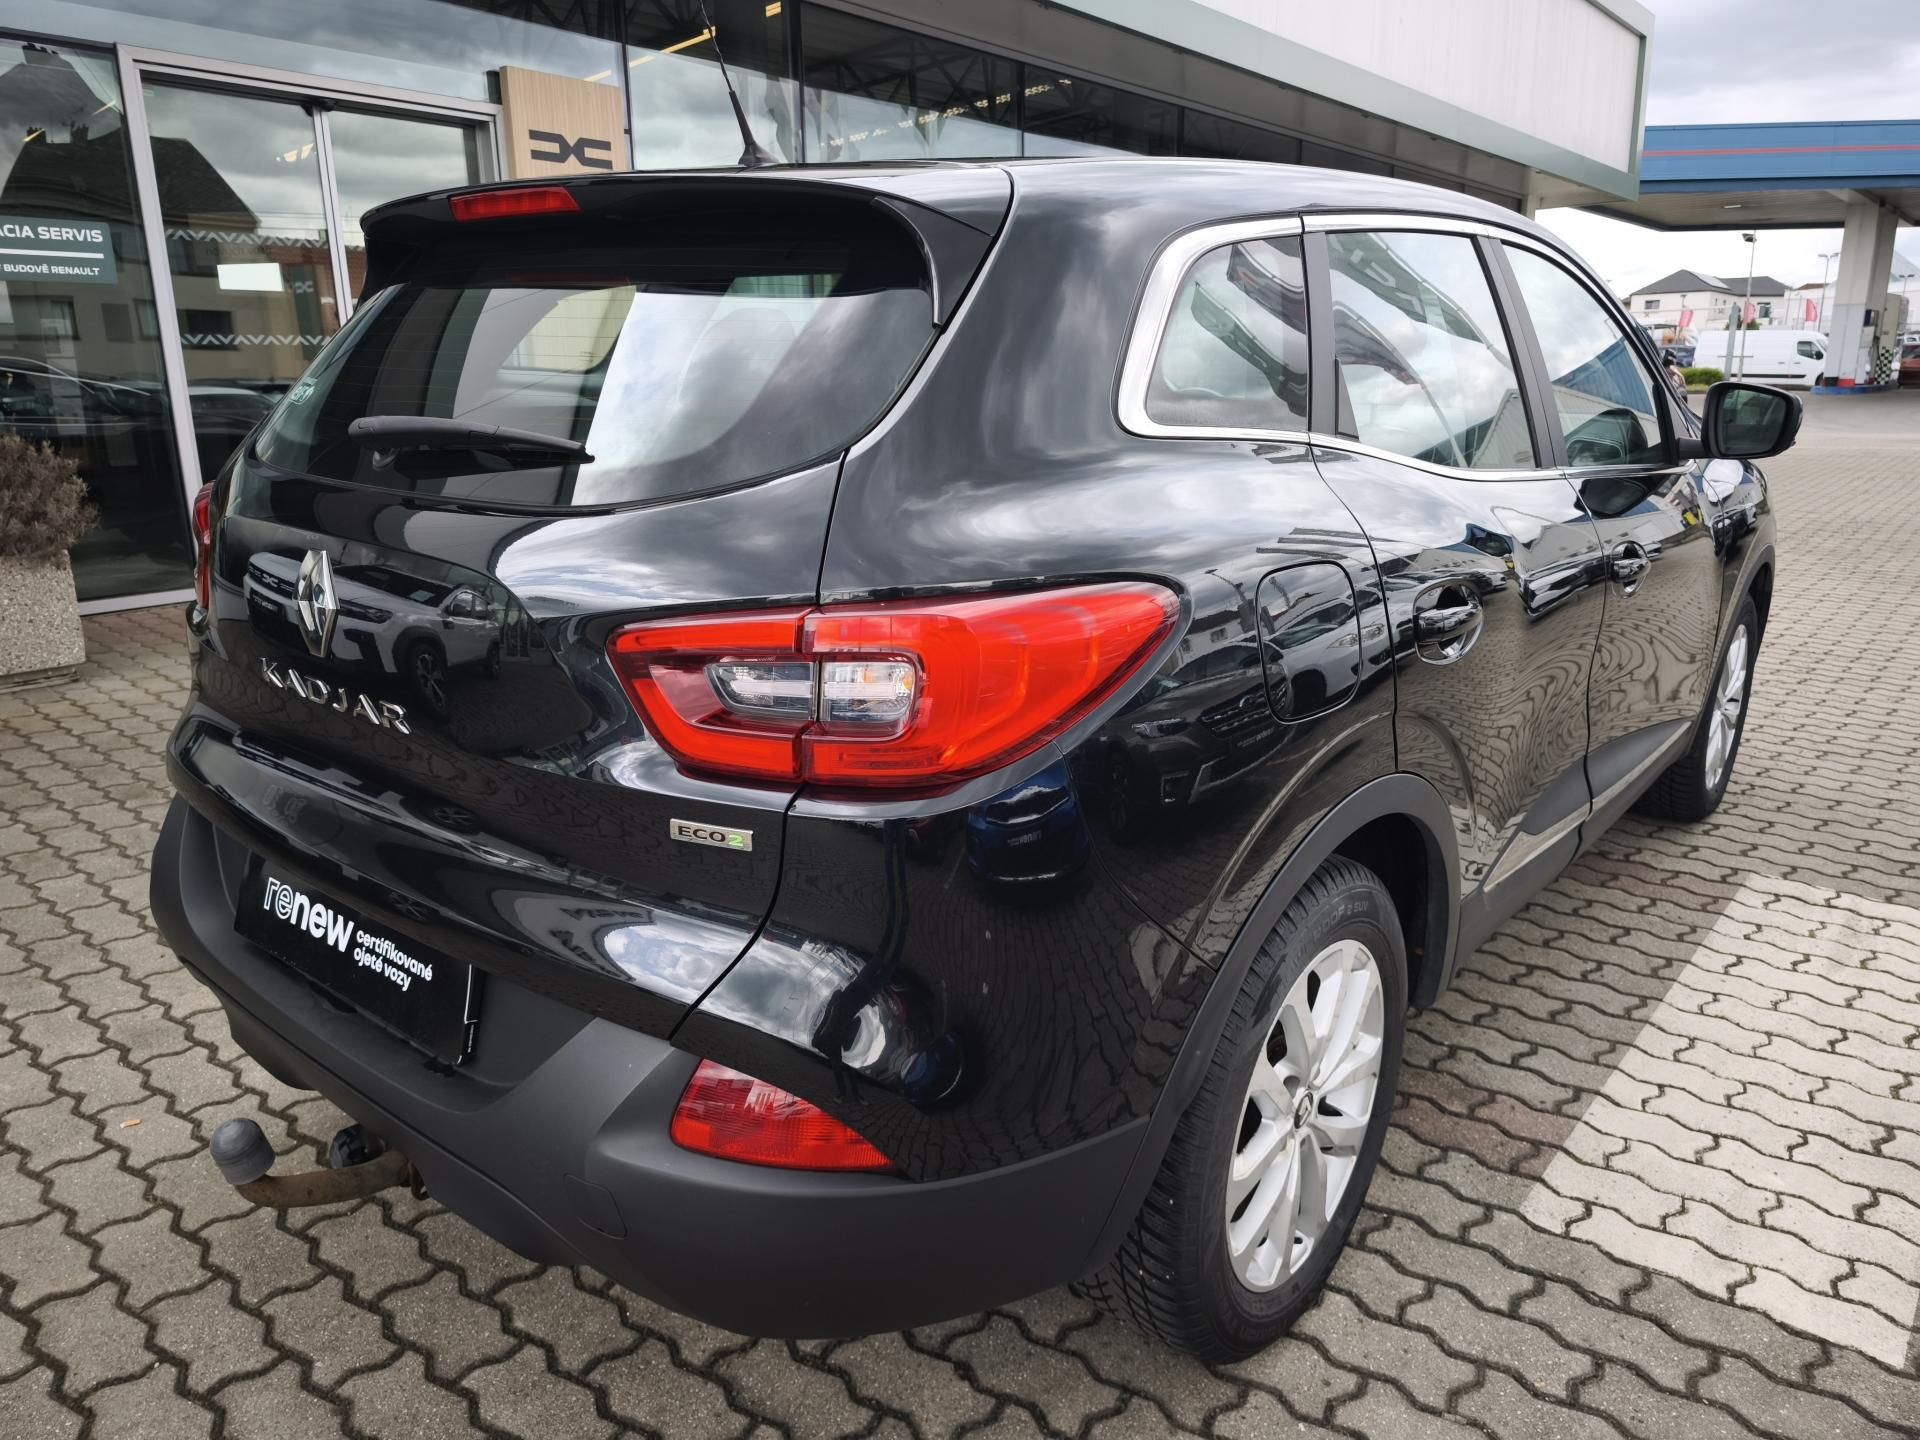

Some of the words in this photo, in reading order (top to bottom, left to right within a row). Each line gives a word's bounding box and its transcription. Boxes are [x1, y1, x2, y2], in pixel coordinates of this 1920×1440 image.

[37, 226, 103, 243] SERVIS
[51, 265, 100, 276] RENAULT
[260, 657, 413, 735] KADJAR
[677, 825, 744, 848] ECO2
[263, 876, 355, 953] renew
[353, 946, 383, 973] ojeté
[384, 963, 412, 992] vozy
[356, 929, 433, 982] certifikované
